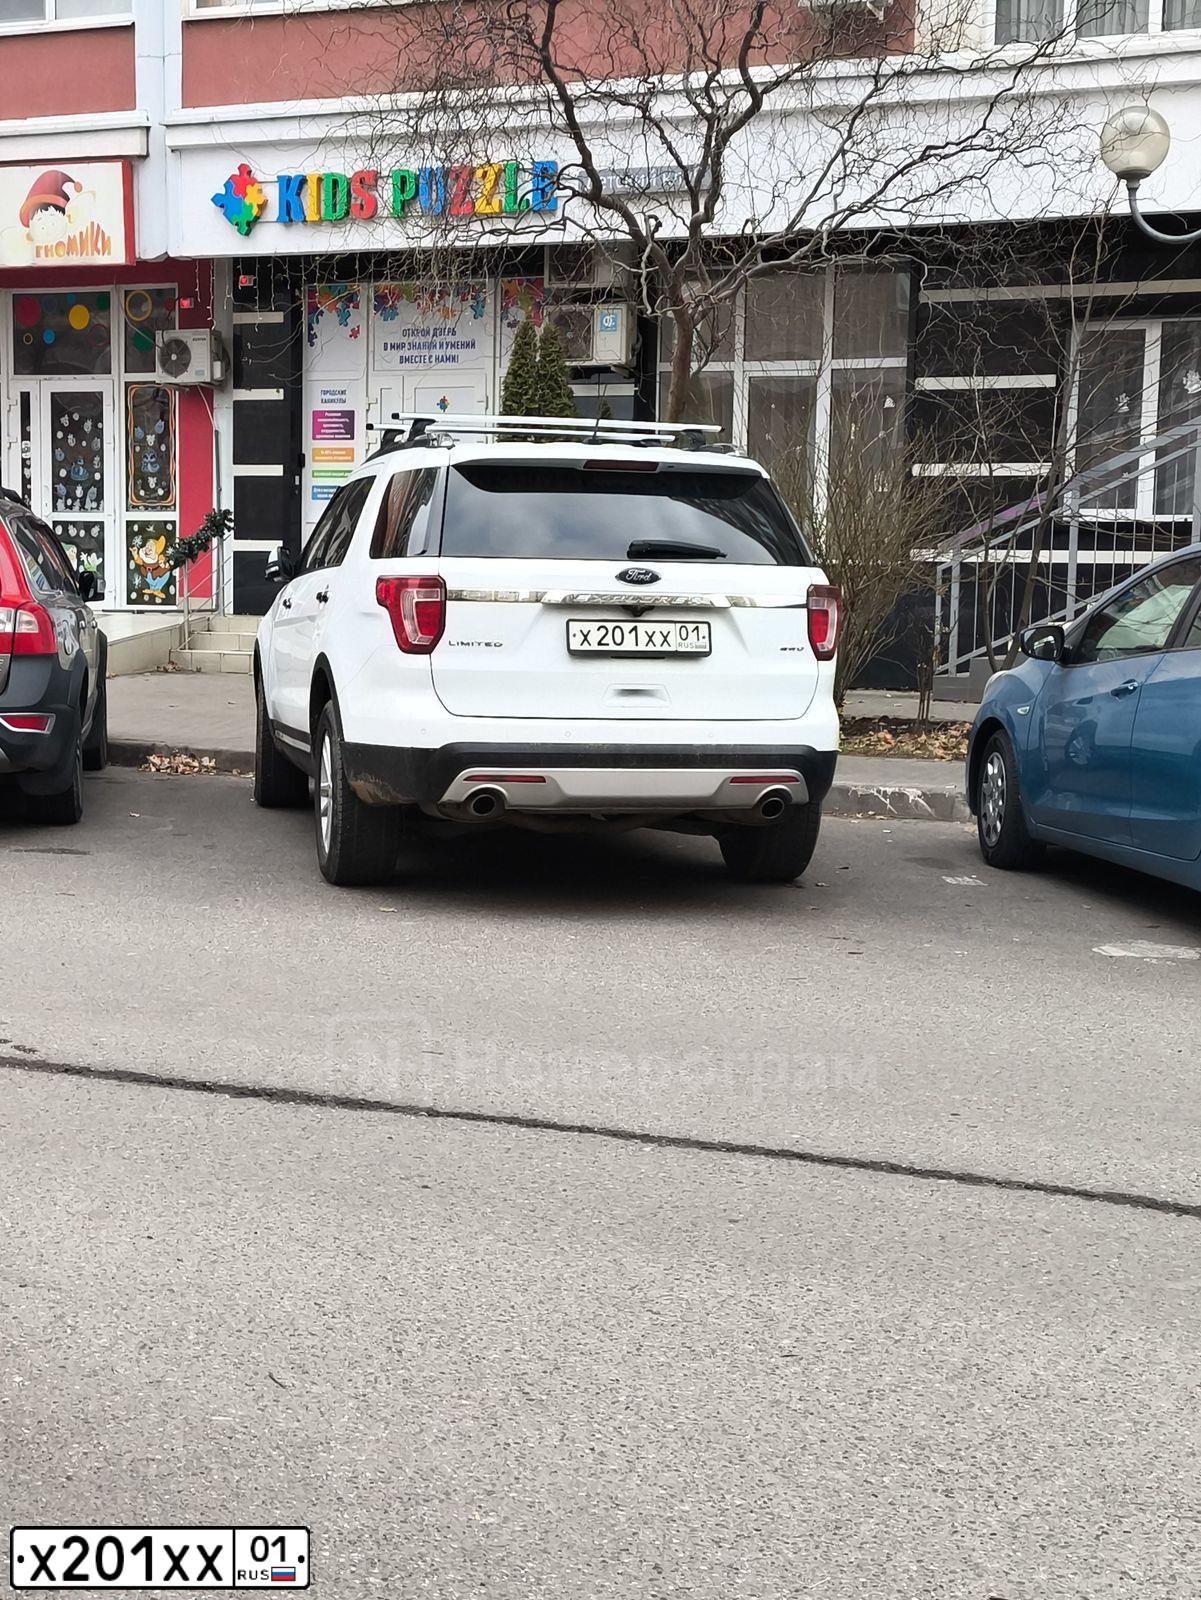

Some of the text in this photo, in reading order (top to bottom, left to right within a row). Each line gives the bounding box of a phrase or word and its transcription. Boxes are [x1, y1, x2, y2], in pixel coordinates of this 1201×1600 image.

[276, 160, 558, 223] KIDS PUZZLE
[402, 326, 430, 338] ОТКРОЙ
[383, 342, 388, 351] В
[389, 341, 406, 351] МИР
[407, 340, 437, 351] ЗНАНИЙ
[445, 338, 476, 350] УМЕНИЙ
[399, 353, 459, 365] ВМЕСТЕ С НАМИ!
[625, 568, 651, 581] Ford
[678, 625, 700, 641] 01
[448, 640, 504, 648] LIMITED
